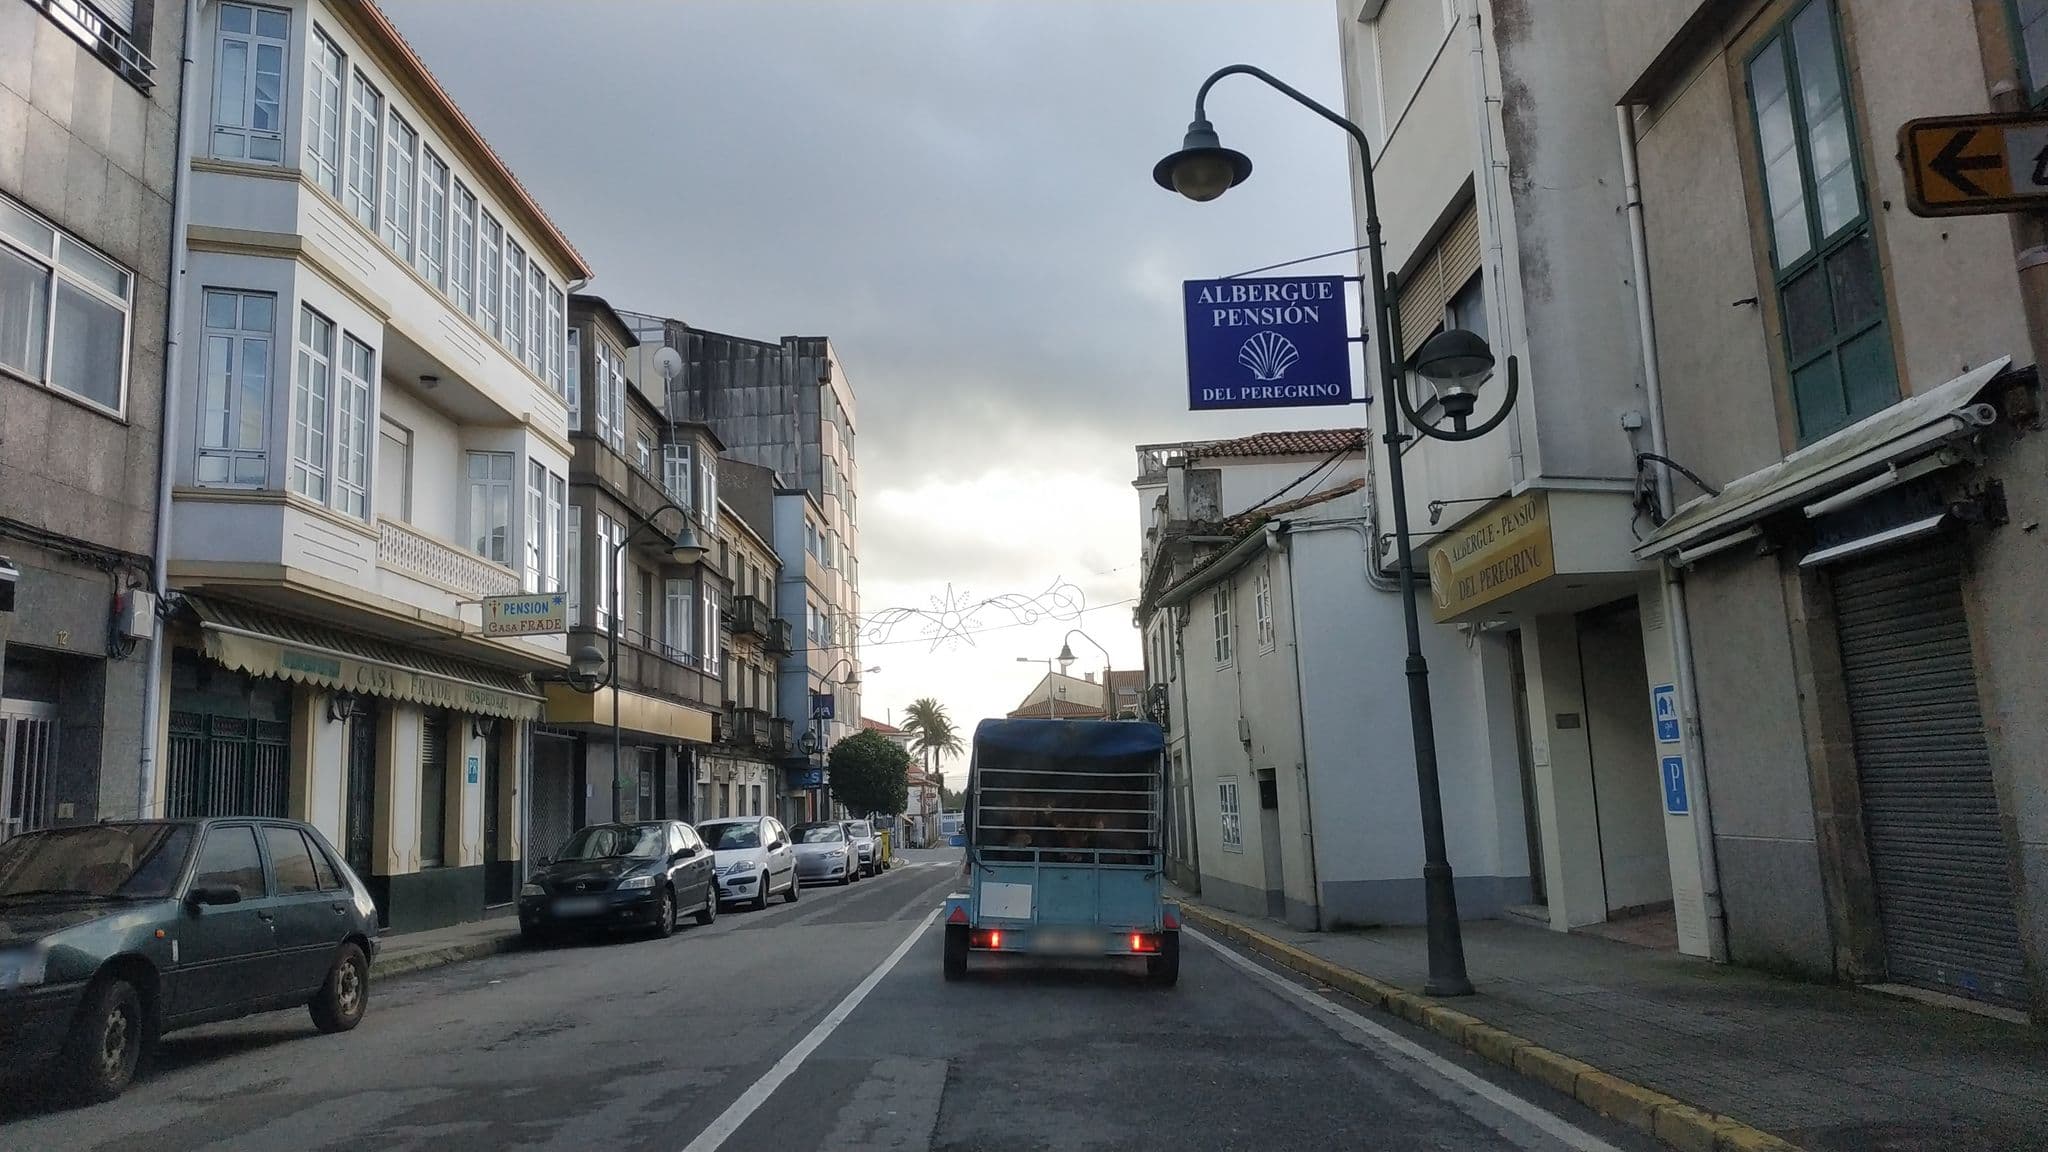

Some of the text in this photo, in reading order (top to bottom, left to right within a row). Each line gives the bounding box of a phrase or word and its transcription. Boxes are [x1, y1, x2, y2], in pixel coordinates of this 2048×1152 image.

[1198, 282, 1333, 304] ALBERGUE
[1213, 302, 1320, 327] PENSIÓN
[1203, 383, 1341, 401] DEL PEREGRINO
[1451, 523, 1496, 563] ALBERGUE
[1458, 579, 1478, 601] DEL
[503, 601, 549, 616] PENSION
[520, 618, 562, 632] FRADE
[356, 665, 395, 691] CASA
[408, 674, 450, 700] FRADE
